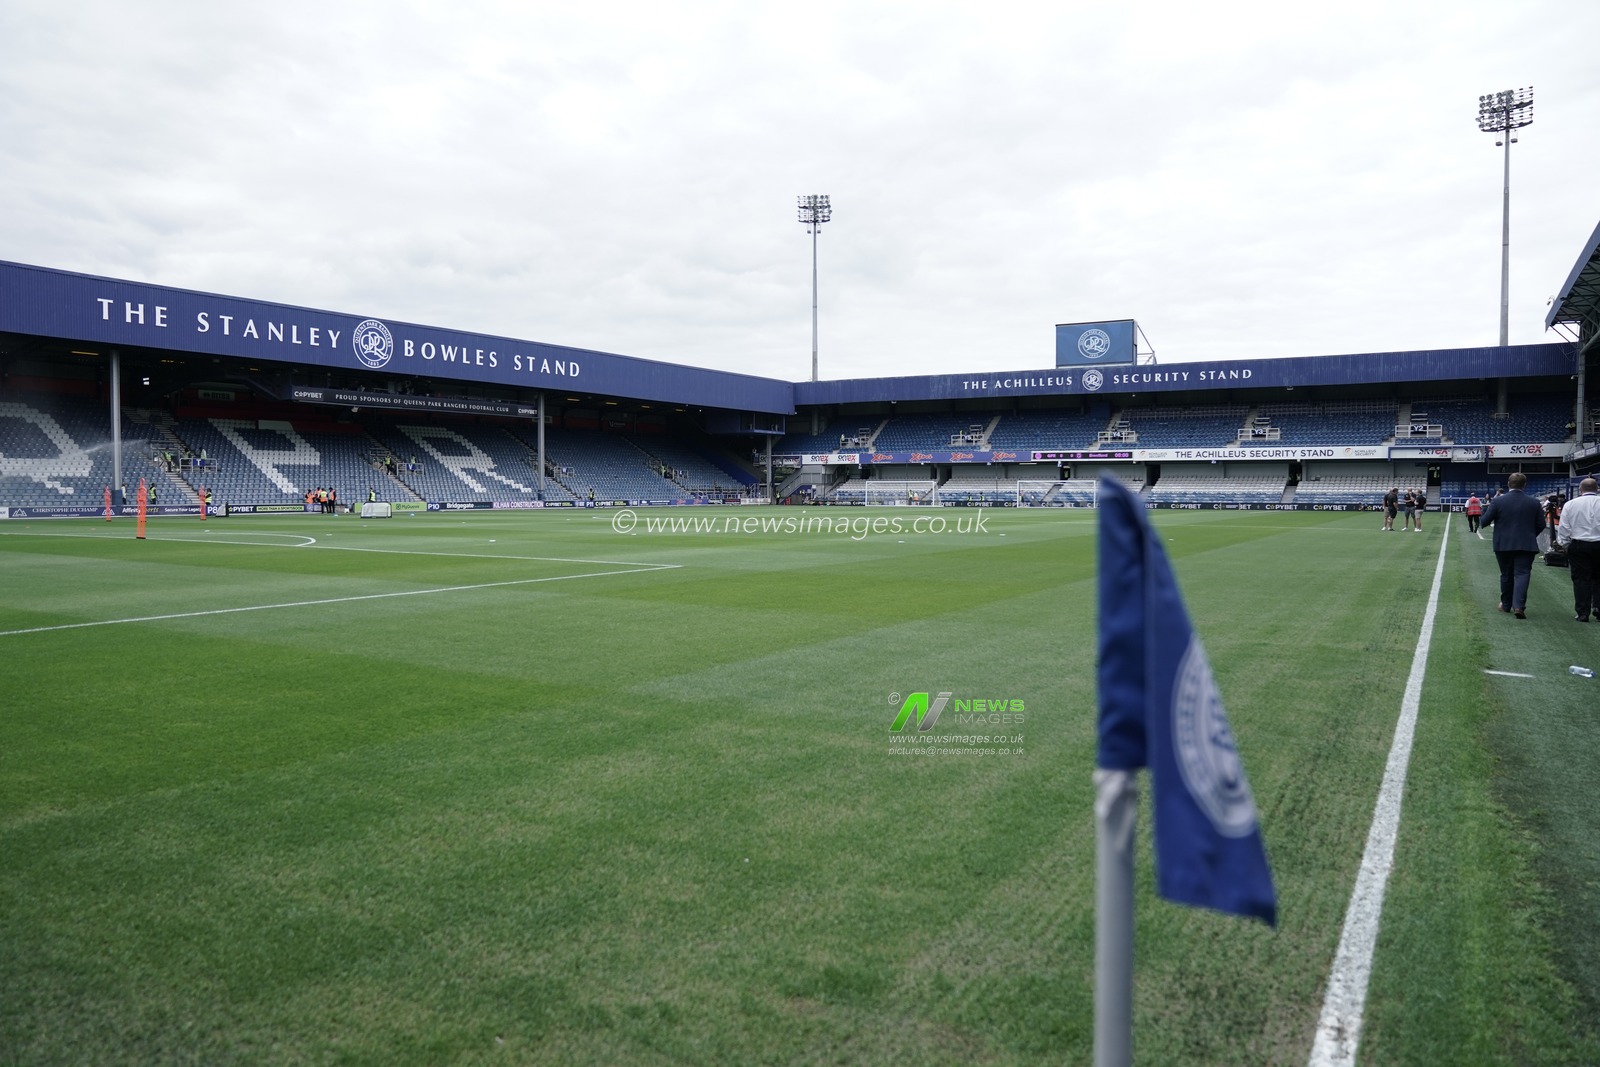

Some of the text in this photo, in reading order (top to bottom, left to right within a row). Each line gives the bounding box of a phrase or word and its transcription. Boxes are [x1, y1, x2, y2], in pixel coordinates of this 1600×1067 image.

[97, 298, 340, 348] THE STANLEY
[404, 340, 580, 377] BOWLES STAND
[963, 376, 1073, 390] THE ACHILLEUS
[1113, 371, 1189, 384] SECURITY
[1200, 369, 1252, 380] STAND
[360, 396, 391, 404] SPONSORS
[1196, 450, 1246, 458] ACHILLEUS
[1250, 449, 1297, 458] SECURITY
[1301, 448, 1334, 457] STAND
[511, 500, 544, 508] CONSTRUCTION
